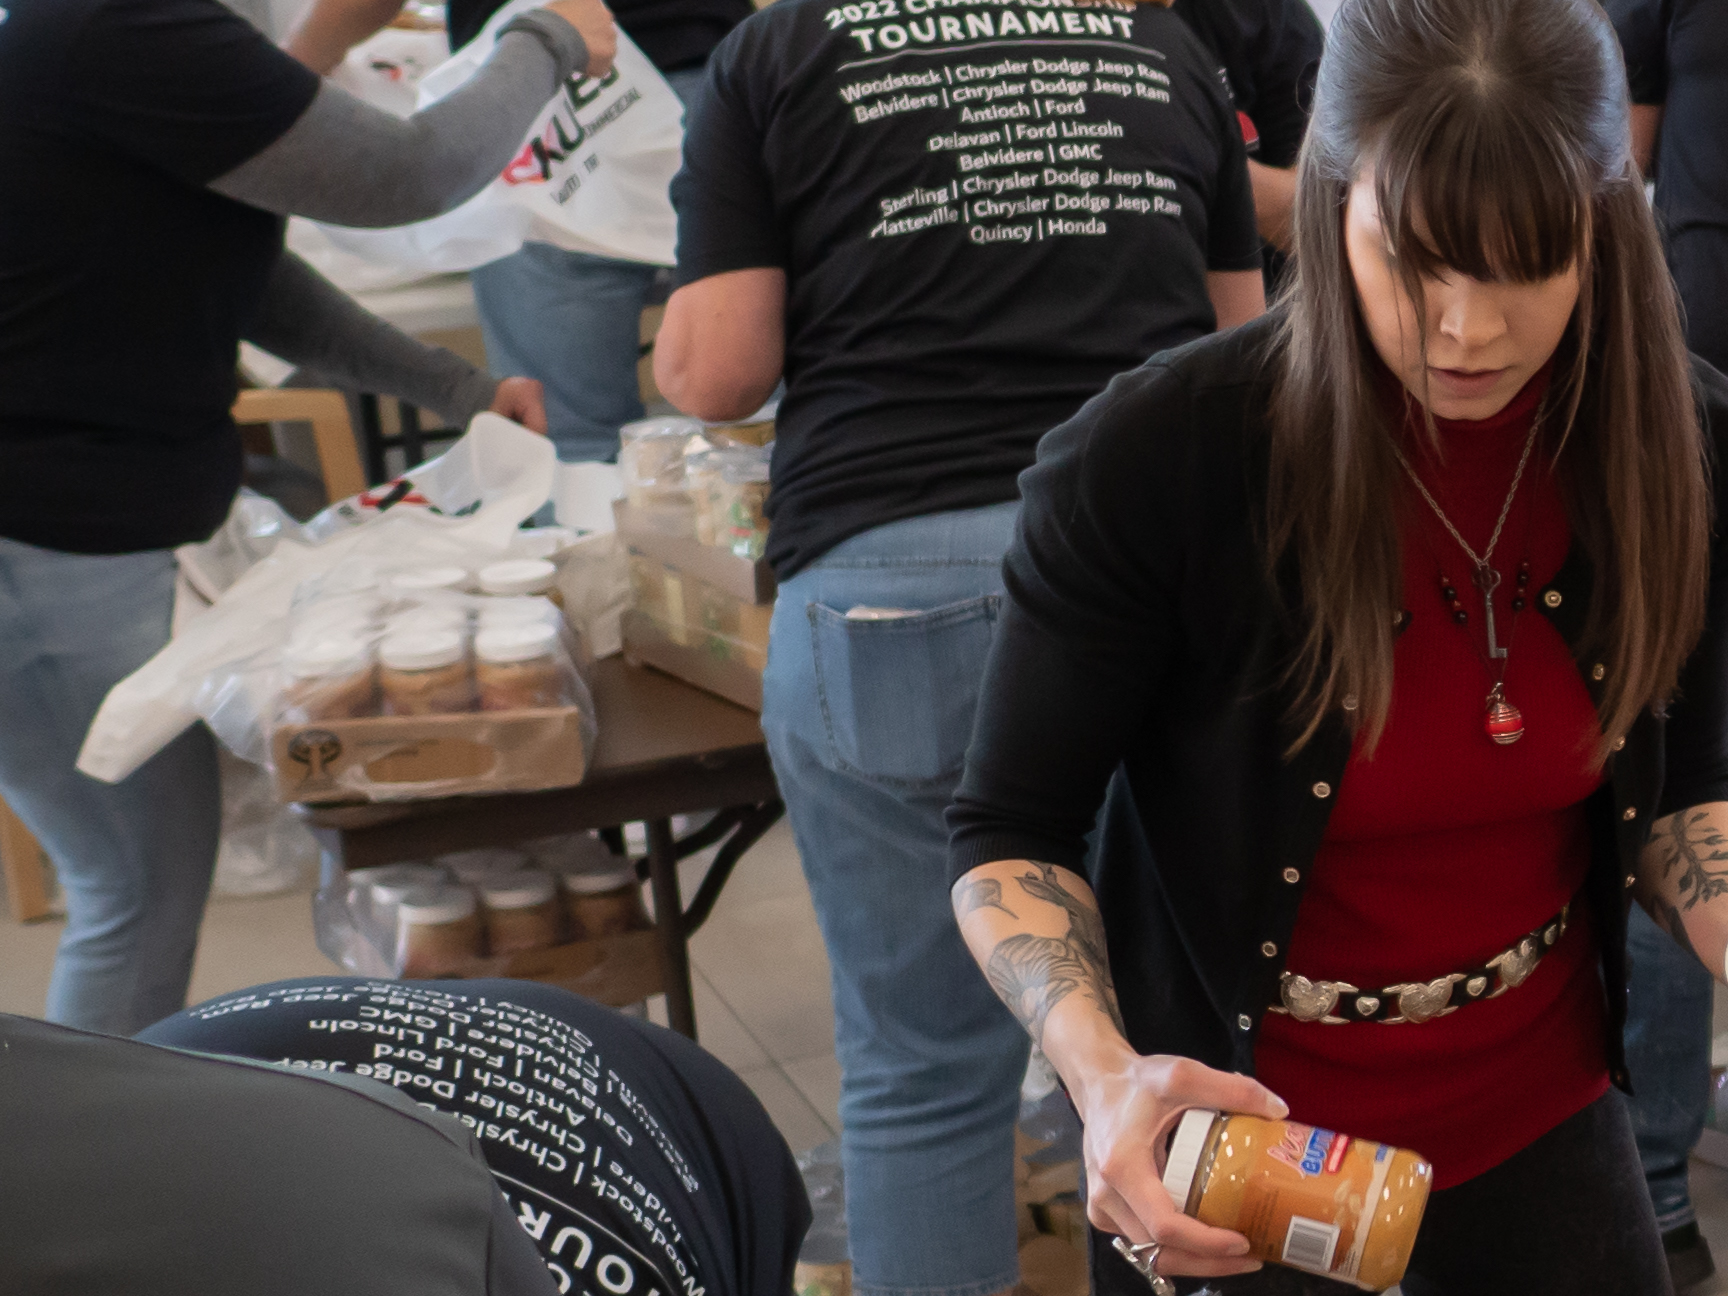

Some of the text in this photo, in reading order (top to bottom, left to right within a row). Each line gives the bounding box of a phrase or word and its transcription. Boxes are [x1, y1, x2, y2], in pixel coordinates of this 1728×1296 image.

[825, 0, 900, 29] 2022
[851, 10, 1134, 52] TOURNAMENT
[841, 57, 1171, 103] Woodstock Chrysler Dodge Jeep Ram
[855, 78, 1171, 124] Belvidere Chrysler Dodge Jeep Ram
[960, 98, 1086, 123] Antioch Ford
[928, 120, 1124, 152] Delavan Ford Lincoln
[959, 144, 1104, 172] Belvidere GMC
[880, 167, 1177, 217] Sterling Chrysler Dodge Jeep Ram
[973, 196, 1050, 218] Chrysler
[1055, 192, 1111, 214] Dodge
[1115, 193, 1151, 214] Jeep
[969, 218, 1107, 243] Quincy Honda
[358, 1005, 439, 1031] GMC
[308, 1018, 634, 1148] Delavan Ford Lincoln
[354, 1061, 457, 1100] Dodge
[373, 1042, 586, 1127] Antioch Ford
[463, 1090, 586, 1155] Chrysler
